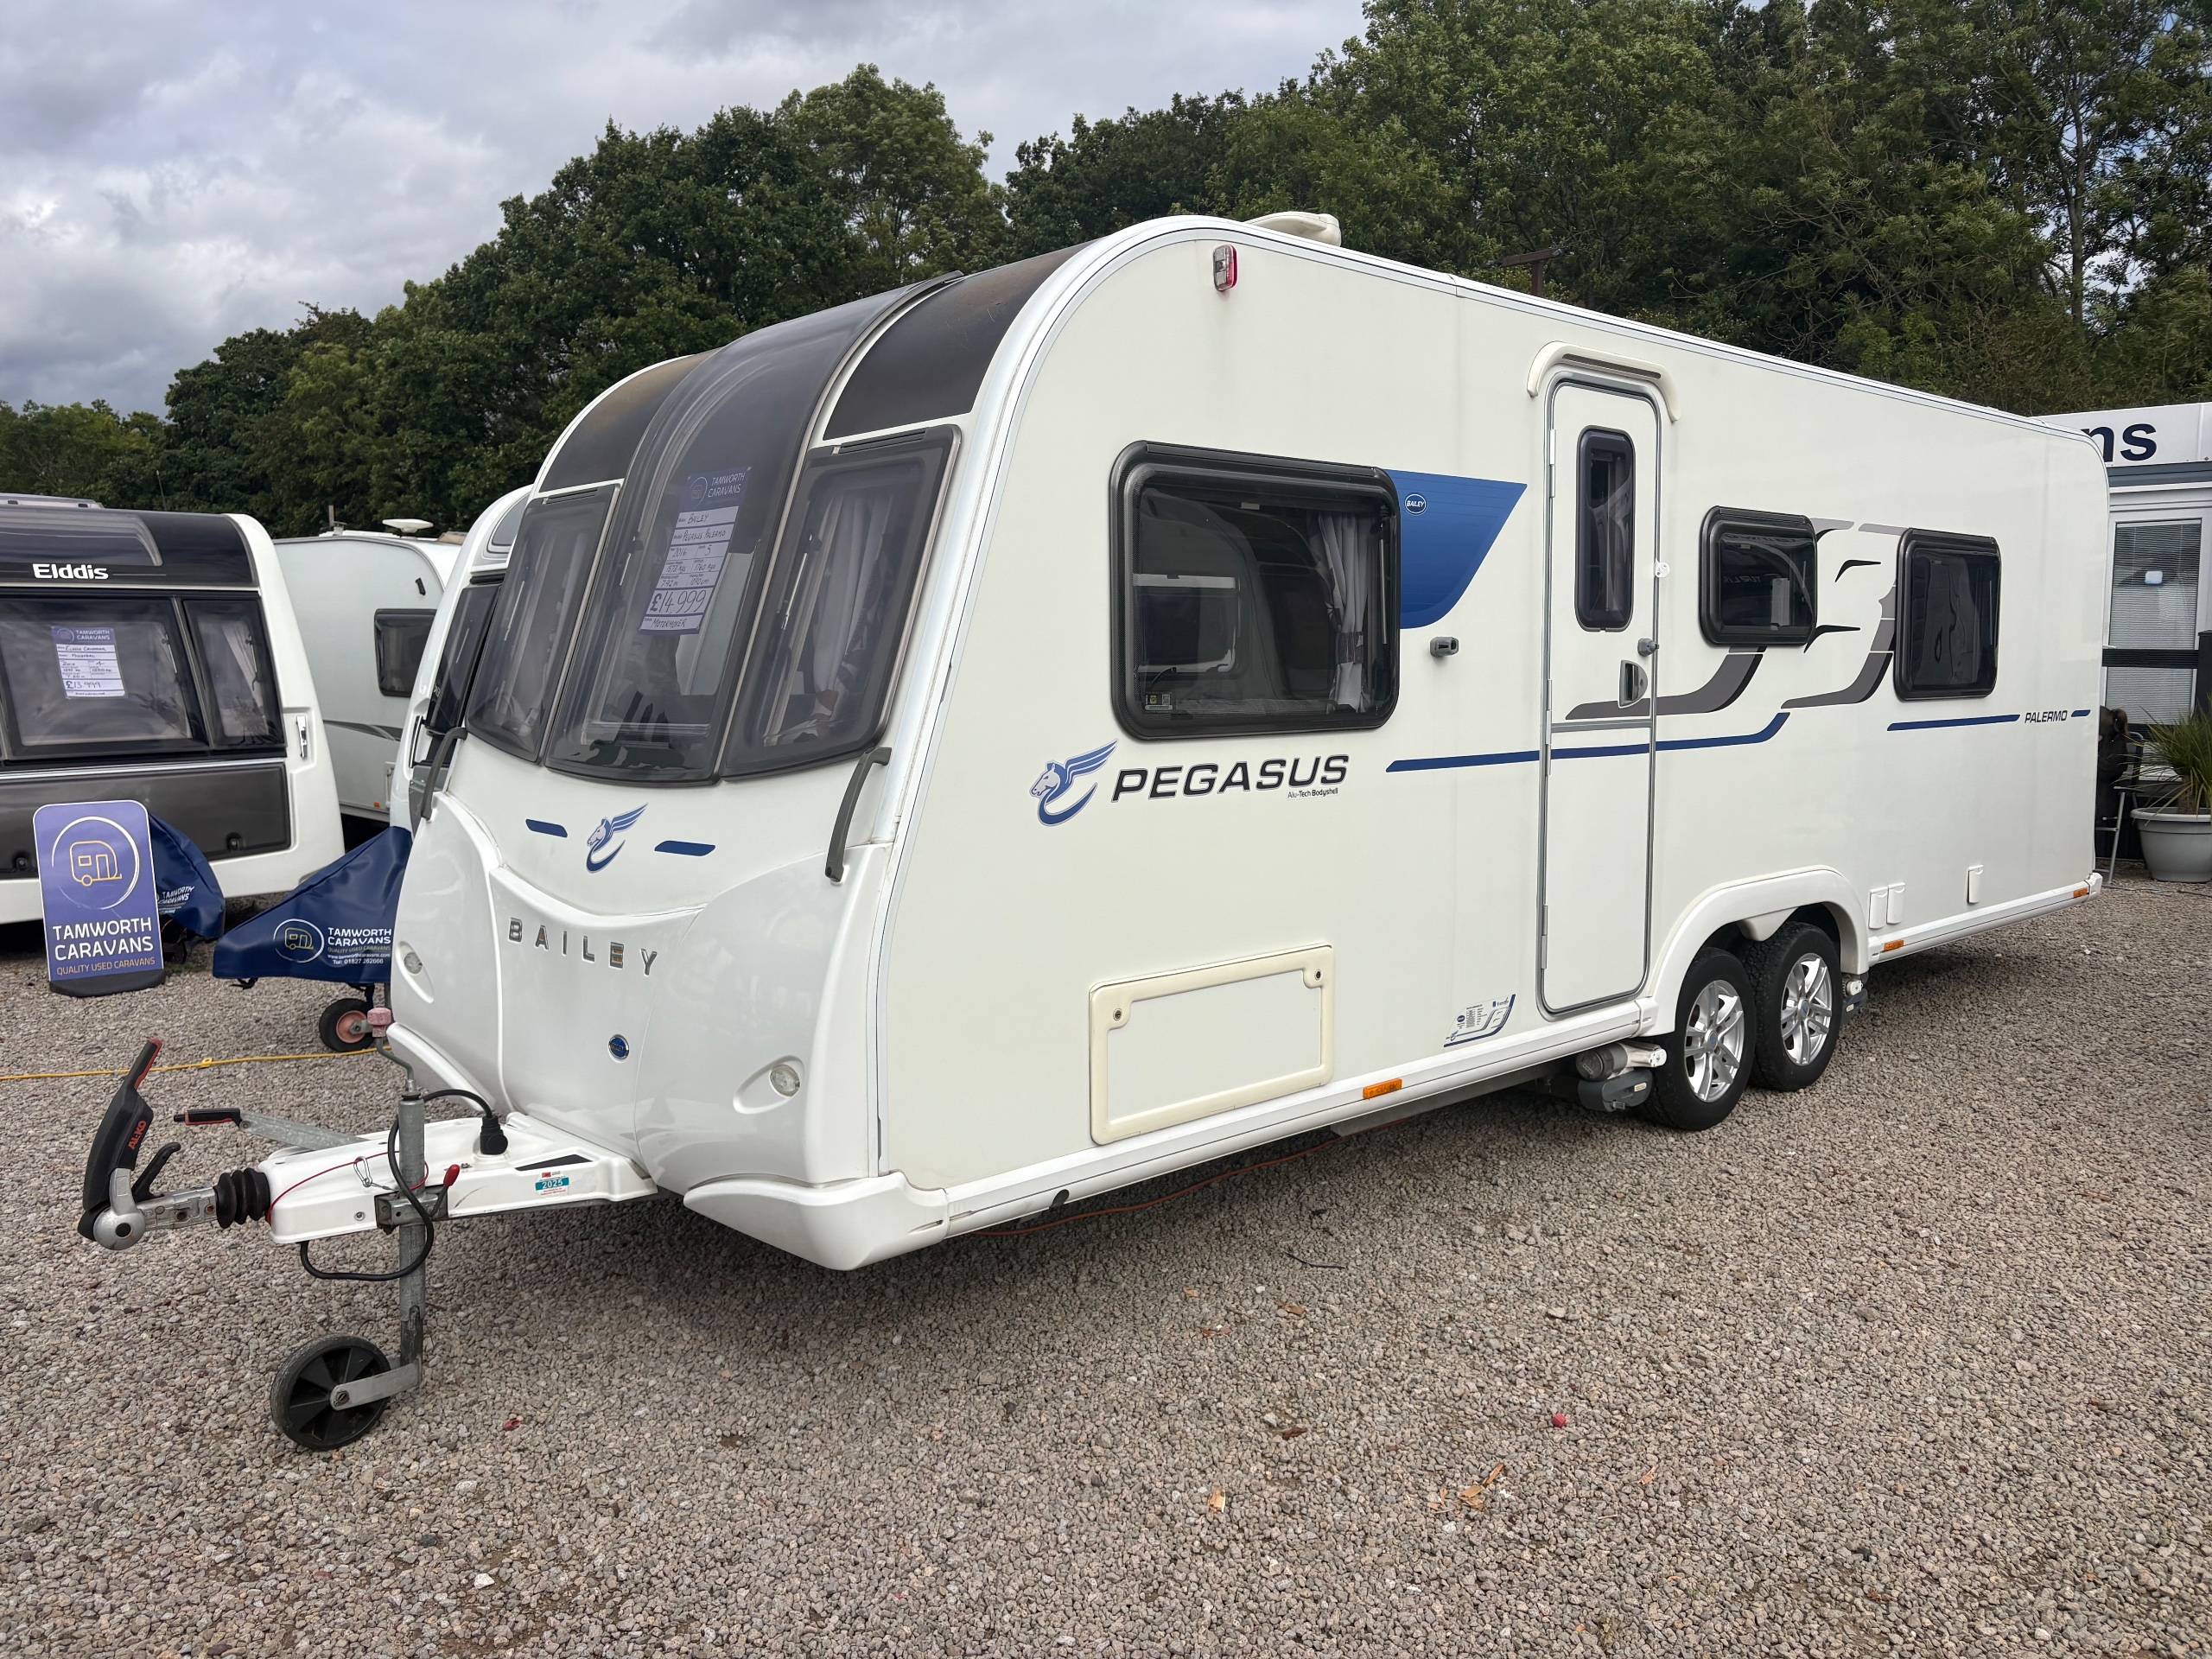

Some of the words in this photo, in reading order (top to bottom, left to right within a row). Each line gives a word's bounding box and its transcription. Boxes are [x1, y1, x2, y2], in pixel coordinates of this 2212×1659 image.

[711, 473, 745, 486] TAMWORTH
[708, 484, 741, 498] CARAVANS
[687, 513, 709, 524] BAILEY
[683, 530, 702, 542] PEGASUS
[703, 528, 726, 539] PALERMO
[672, 547, 687, 557] 2016
[704, 544, 713, 556] 5
[32, 563, 109, 580] Elddis
[2024, 709, 2068, 723] PALERMO
[1111, 754, 1349, 803] PEGASUS
[1287, 790, 1311, 798] Alu-Tech
[1312, 787, 1338, 797] Bodyshell
[53, 917, 152, 940] TAMWORTH
[328, 927, 391, 937] TAMWORTH
[54, 936, 154, 961] CARAVANS
[327, 937, 391, 946] CARAVANS
[508, 918, 658, 976] BAILEY
[57, 963, 89, 976] QUALITY
[92, 962, 112, 972] USED
[114, 957, 156, 968] CARAVANS
[542, 1179, 563, 1189] 2025
